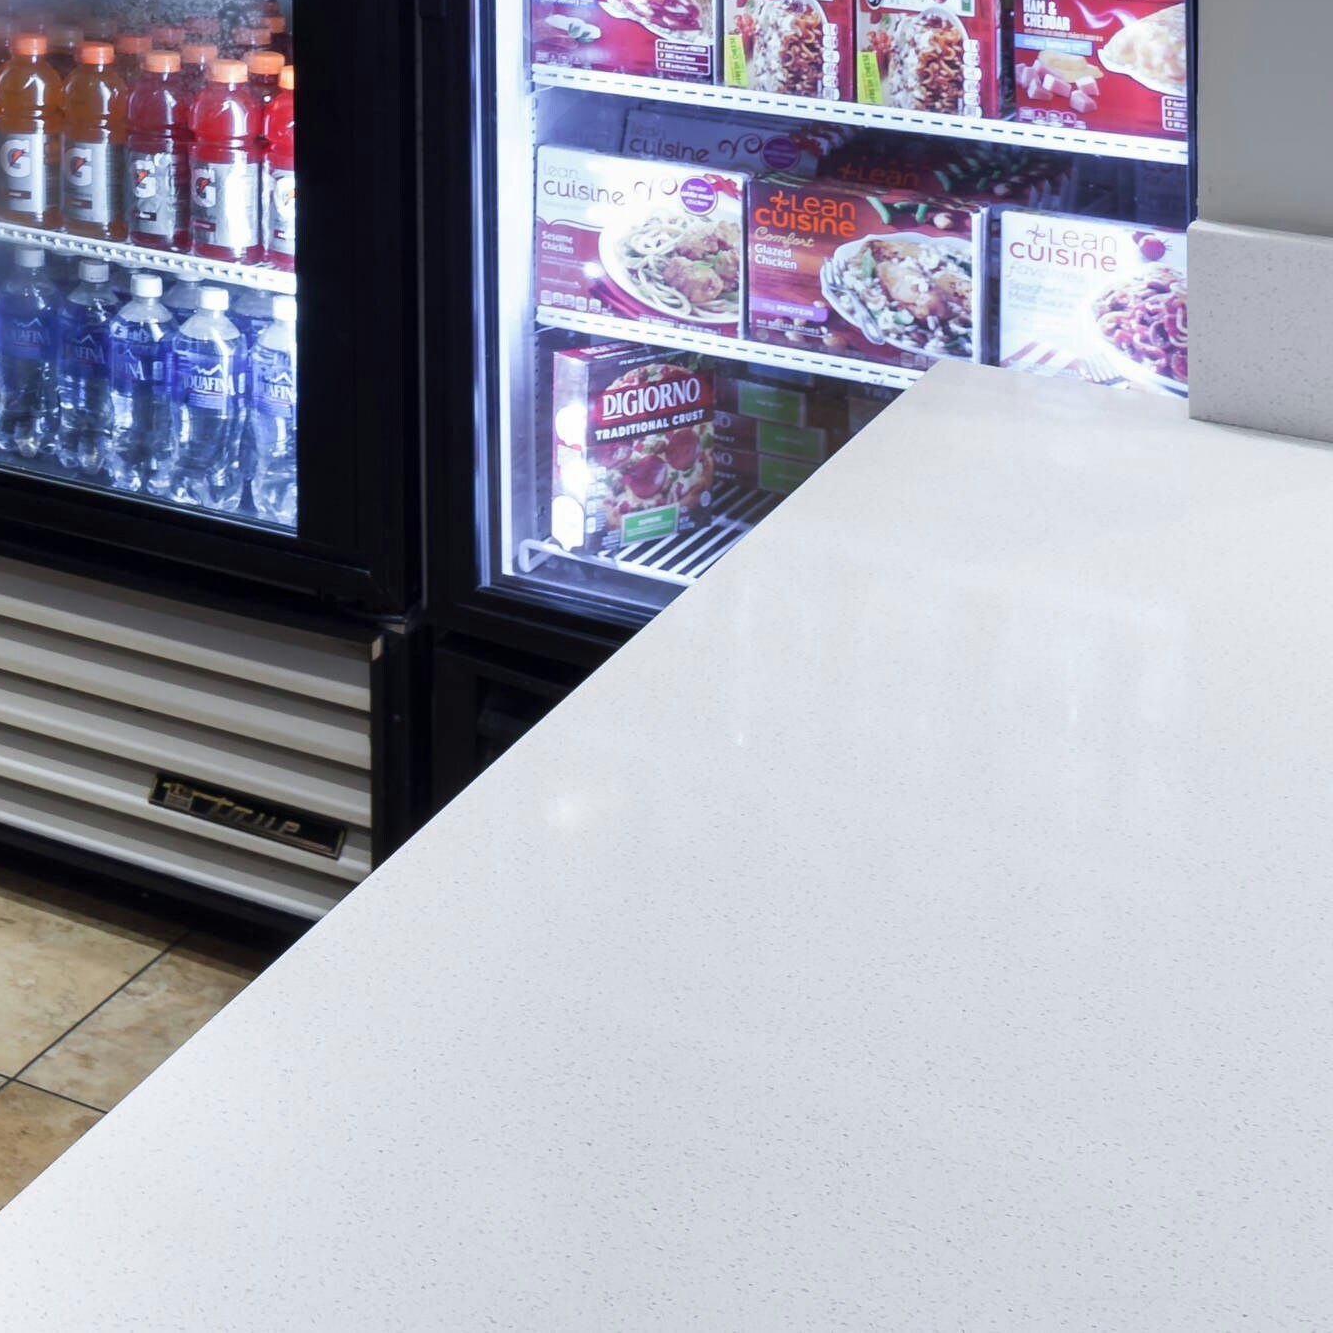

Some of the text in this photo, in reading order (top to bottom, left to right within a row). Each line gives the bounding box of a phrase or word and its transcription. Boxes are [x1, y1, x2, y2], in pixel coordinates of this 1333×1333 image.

[1023, 1, 1058, 15] HAM &
[1023, 14, 1071, 31] CHEDDAR
[543, 178, 626, 207] cuisine
[541, 230, 574, 245] Sesame
[754, 226, 815, 248] Comfort
[541, 241, 574, 255] Chicken
[754, 243, 793, 259] Glazed
[754, 254, 797, 271] Chicken
[595, 409, 705, 442] TRADITIONAL CRUST
